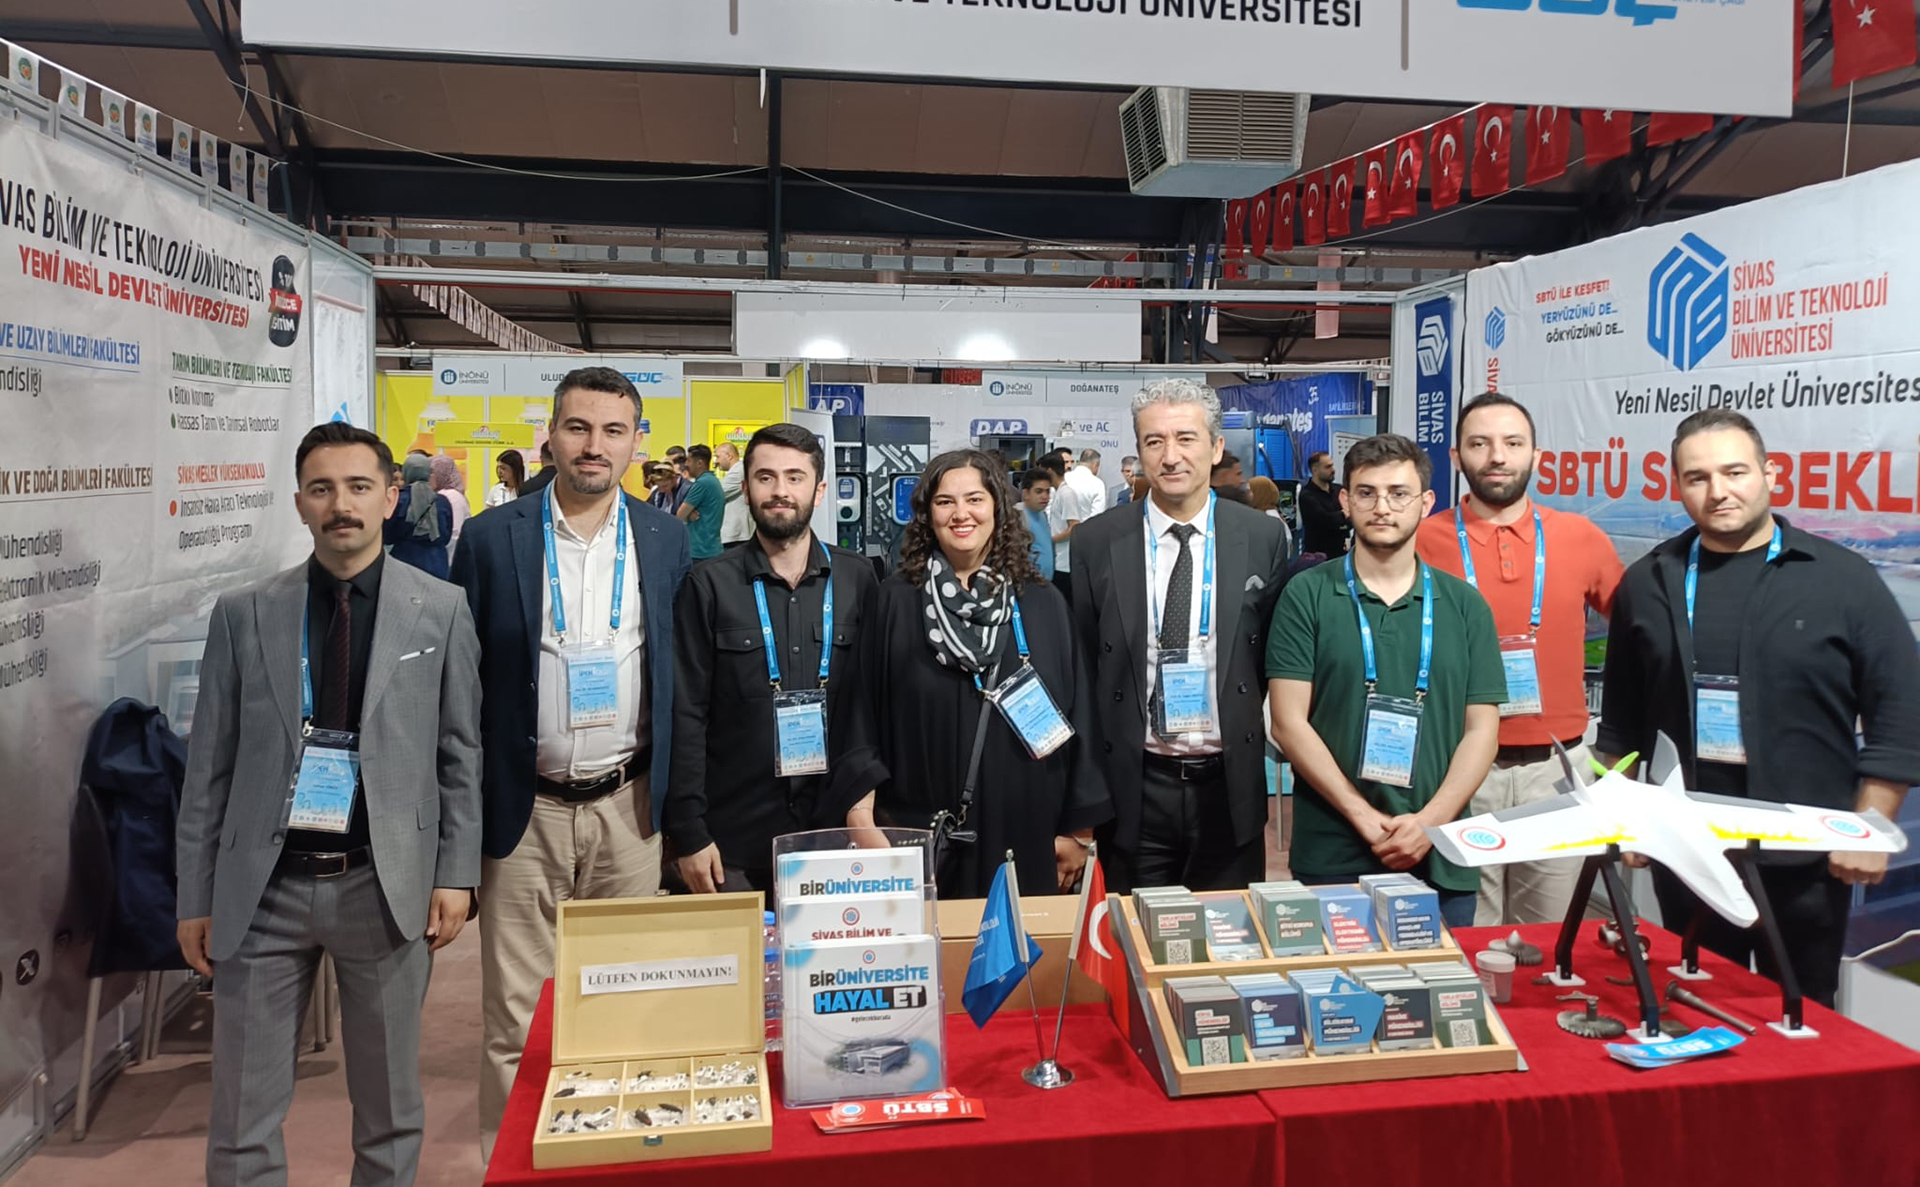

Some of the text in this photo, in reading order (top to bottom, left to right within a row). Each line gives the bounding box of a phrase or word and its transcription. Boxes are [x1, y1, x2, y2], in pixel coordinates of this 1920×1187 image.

[42, 190, 88, 250] BİLİM
[91, 212, 110, 257] VE
[191, 243, 264, 302] ÜNİVERSİTESİ
[18, 244, 249, 328] YENİ NESİL DEVLET ÜNİVERSİTESİ
[1733, 260, 1775, 292] SİVAS
[1536, 287, 1557, 304] SBTÜ
[1559, 285, 1572, 299] İLE
[1732, 272, 1889, 326] BİLİM VE TEKNOLOJİ
[1541, 302, 1596, 324] YERYÜZÜNÜ
[17, 325, 45, 352] UZAY
[48, 326, 90, 359] BİLİMLERİ
[1546, 322, 1602, 343] GÖKYÜZÜNÜ
[1731, 317, 1833, 360] ÜNİVERSİTESİ
[458, 370, 489, 379] İNÖNÜ
[1006, 382, 1032, 390] İNÖNÜ
[1071, 384, 1119, 394] DOĞANATEŞ
[1614, 389, 1650, 415] Yeni
[1655, 384, 1702, 414] Nesil
[1709, 381, 1775, 411] Devlet
[976, 421, 1023, 435] DAP
[1418, 392, 1432, 443] BİLİM
[1431, 390, 1447, 444] SİVAS
[14, 470, 31, 494] VE
[33, 465, 59, 494] DOĞA
[61, 463, 102, 492] BİLİMLERİ
[104, 463, 153, 489] FAKÜLTESİ
[1536, 436, 1629, 499] SBTÜ
[811, 927, 892, 941] SİVAS BİLİM VE
[588, 966, 733, 986] LÜTFEN DOKUNMAYIN!
[814, 986, 923, 1013] HAYAL ET
[882, 1101, 949, 1120] SBTÜ
